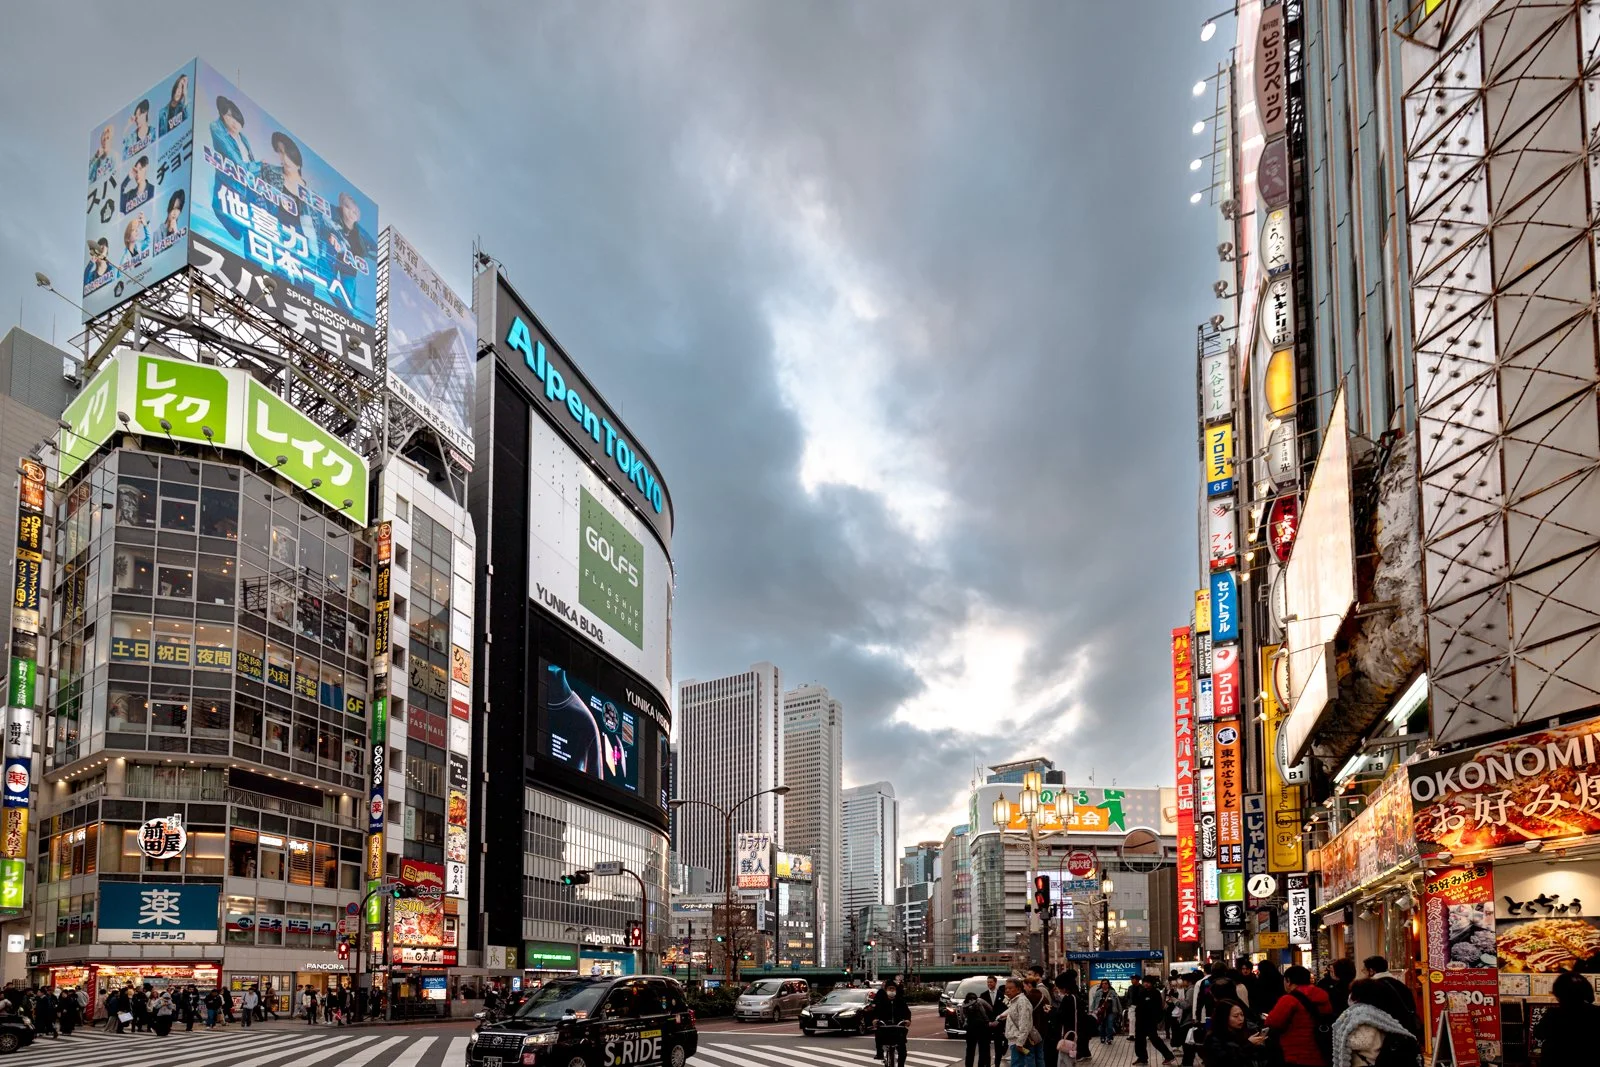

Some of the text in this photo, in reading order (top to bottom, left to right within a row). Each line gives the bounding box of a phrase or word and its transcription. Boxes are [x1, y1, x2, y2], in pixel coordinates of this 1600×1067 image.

[248, 230, 353, 309] 日本一へ
[286, 287, 365, 335] SPICE CHOCOLATE
[312, 310, 345, 331] GROUP
[1272, 331, 1291, 345] 6F
[1210, 360, 1225, 411] 戸谷ビル
[257, 399, 353, 486] レイク
[1213, 430, 1226, 477] プロミス
[1213, 480, 1228, 491] 6F
[20, 516, 31, 541] Table
[30, 515, 41, 548] Cheese
[585, 526, 638, 589] GOLF5
[585, 569, 639, 618] FLAGSHIP
[536, 582, 605, 646] YUNIKA BLDG.
[606, 600, 639, 632] STORE
[1216, 580, 1231, 633] セントラル
[157, 645, 190, 663] 祝日
[197, 648, 231, 666] 夜間
[237, 651, 262, 668] 保険
[237, 661, 261, 677] 診療
[268, 667, 289, 686] 内科
[295, 674, 317, 690] 予約
[295, 683, 317, 698] 不要
[1218, 672, 1233, 705] アコム
[347, 698, 364, 712] 6F
[625, 687, 655, 720] YUNIKA
[1220, 706, 1233, 714] 3F
[9, 721, 22, 746] 前田屋
[8, 770, 27, 787] 薬
[1219, 748, 1237, 809] 東京ぶらんど
[1289, 770, 1304, 780] B1
[371, 801, 382, 814] 薬
[8, 808, 22, 857] 肉汁水餃子
[143, 820, 180, 852] 前田屋
[1220, 811, 1229, 842] RESALE
[1230, 810, 1239, 840] LUXURY
[740, 836, 768, 851] カラオケ
[1220, 845, 1229, 863] 買取
[1232, 844, 1241, 862] 販売
[741, 859, 766, 874] 鉄人
[1070, 859, 1091, 870] 消火栓
[3, 865, 17, 899] レイク
[1226, 875, 1236, 897] レイク
[1428, 866, 1487, 894] お好み焼き
[138, 889, 181, 925] 薬
[1292, 891, 1308, 939] 一軒め酒場
[131, 931, 185, 940] ミネドラッグ
[259, 917, 331, 932] ミネドラッグ
[1426, 896, 1446, 971] 食べ飲み放題
[604, 1031, 640, 1042] タクシーアプリ
[604, 1037, 663, 1067] S.RIDE
